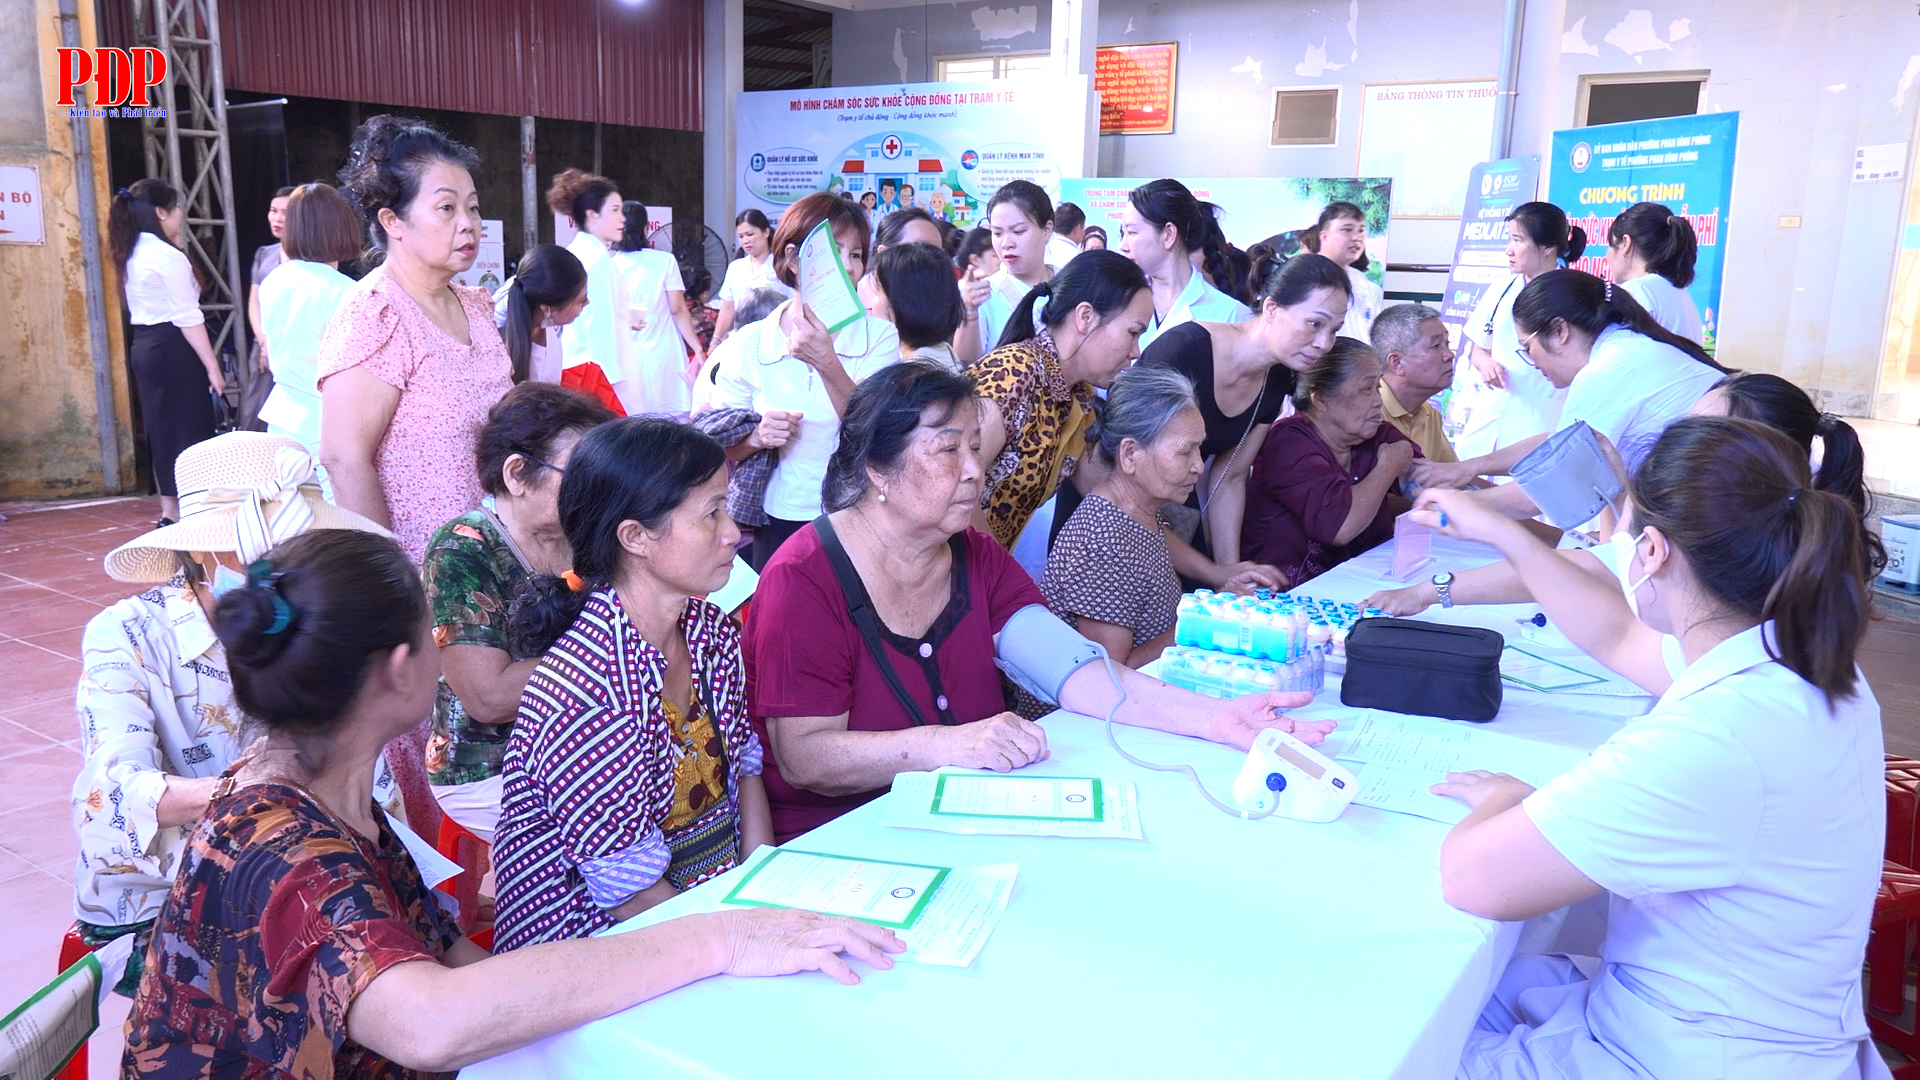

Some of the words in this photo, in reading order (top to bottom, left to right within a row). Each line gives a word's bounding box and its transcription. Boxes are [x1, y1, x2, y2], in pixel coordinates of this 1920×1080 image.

[790, 98, 802, 111] MÔ
[804, 98, 821, 110] HÌNH
[823, 96, 844, 110] CHĂM
[847, 96, 862, 108] SÓC
[864, 95, 880, 108] SỨC
[882, 92, 902, 108] KHỎE
[904, 93, 926, 109] CỘNG
[929, 90, 951, 106] ĐỒNG
[954, 93, 966, 107] TẠI
[970, 92, 994, 106] TRẠM
[996, 92, 1002, 102] Y
[1377, 88, 1404, 100] BẢNG
[1408, 88, 1443, 100] THÔNG
[1446, 90, 1464, 98] TIN
[1601, 144, 1611, 154] BAN
[1612, 141, 1626, 152] NHÂN
[1627, 140, 1638, 152] DÂN
[1638, 138, 1660, 150] PHƯỜNG
[1660, 138, 1676, 148] PHAN
[1676, 136, 1690, 147] ĐÌNH
[1691, 134, 1711, 146] PHÙNG
[982, 151, 996, 160] QUẢN
[1004, 152, 1018, 160] BỆNH
[1602, 158, 1616, 169] TRẠM
[1616, 158, 1620, 166] Y
[1620, 154, 1628, 166] TẾ
[1628, 154, 1648, 166] PHƯỜNG
[1649, 154, 1664, 164] PHAN
[1664, 152, 1678, 162] ĐÌNH
[1679, 150, 1698, 162] PHÙNG
[11, 190, 32, 207] BỘ
[1085, 189, 1102, 197] TRUNG
[1580, 186, 1638, 204] CHƯƠNG
[1641, 182, 1685, 202] TRÌNH
[1463, 222, 1509, 240] MEDLATE
[1696, 207, 1719, 246] PHÍ
